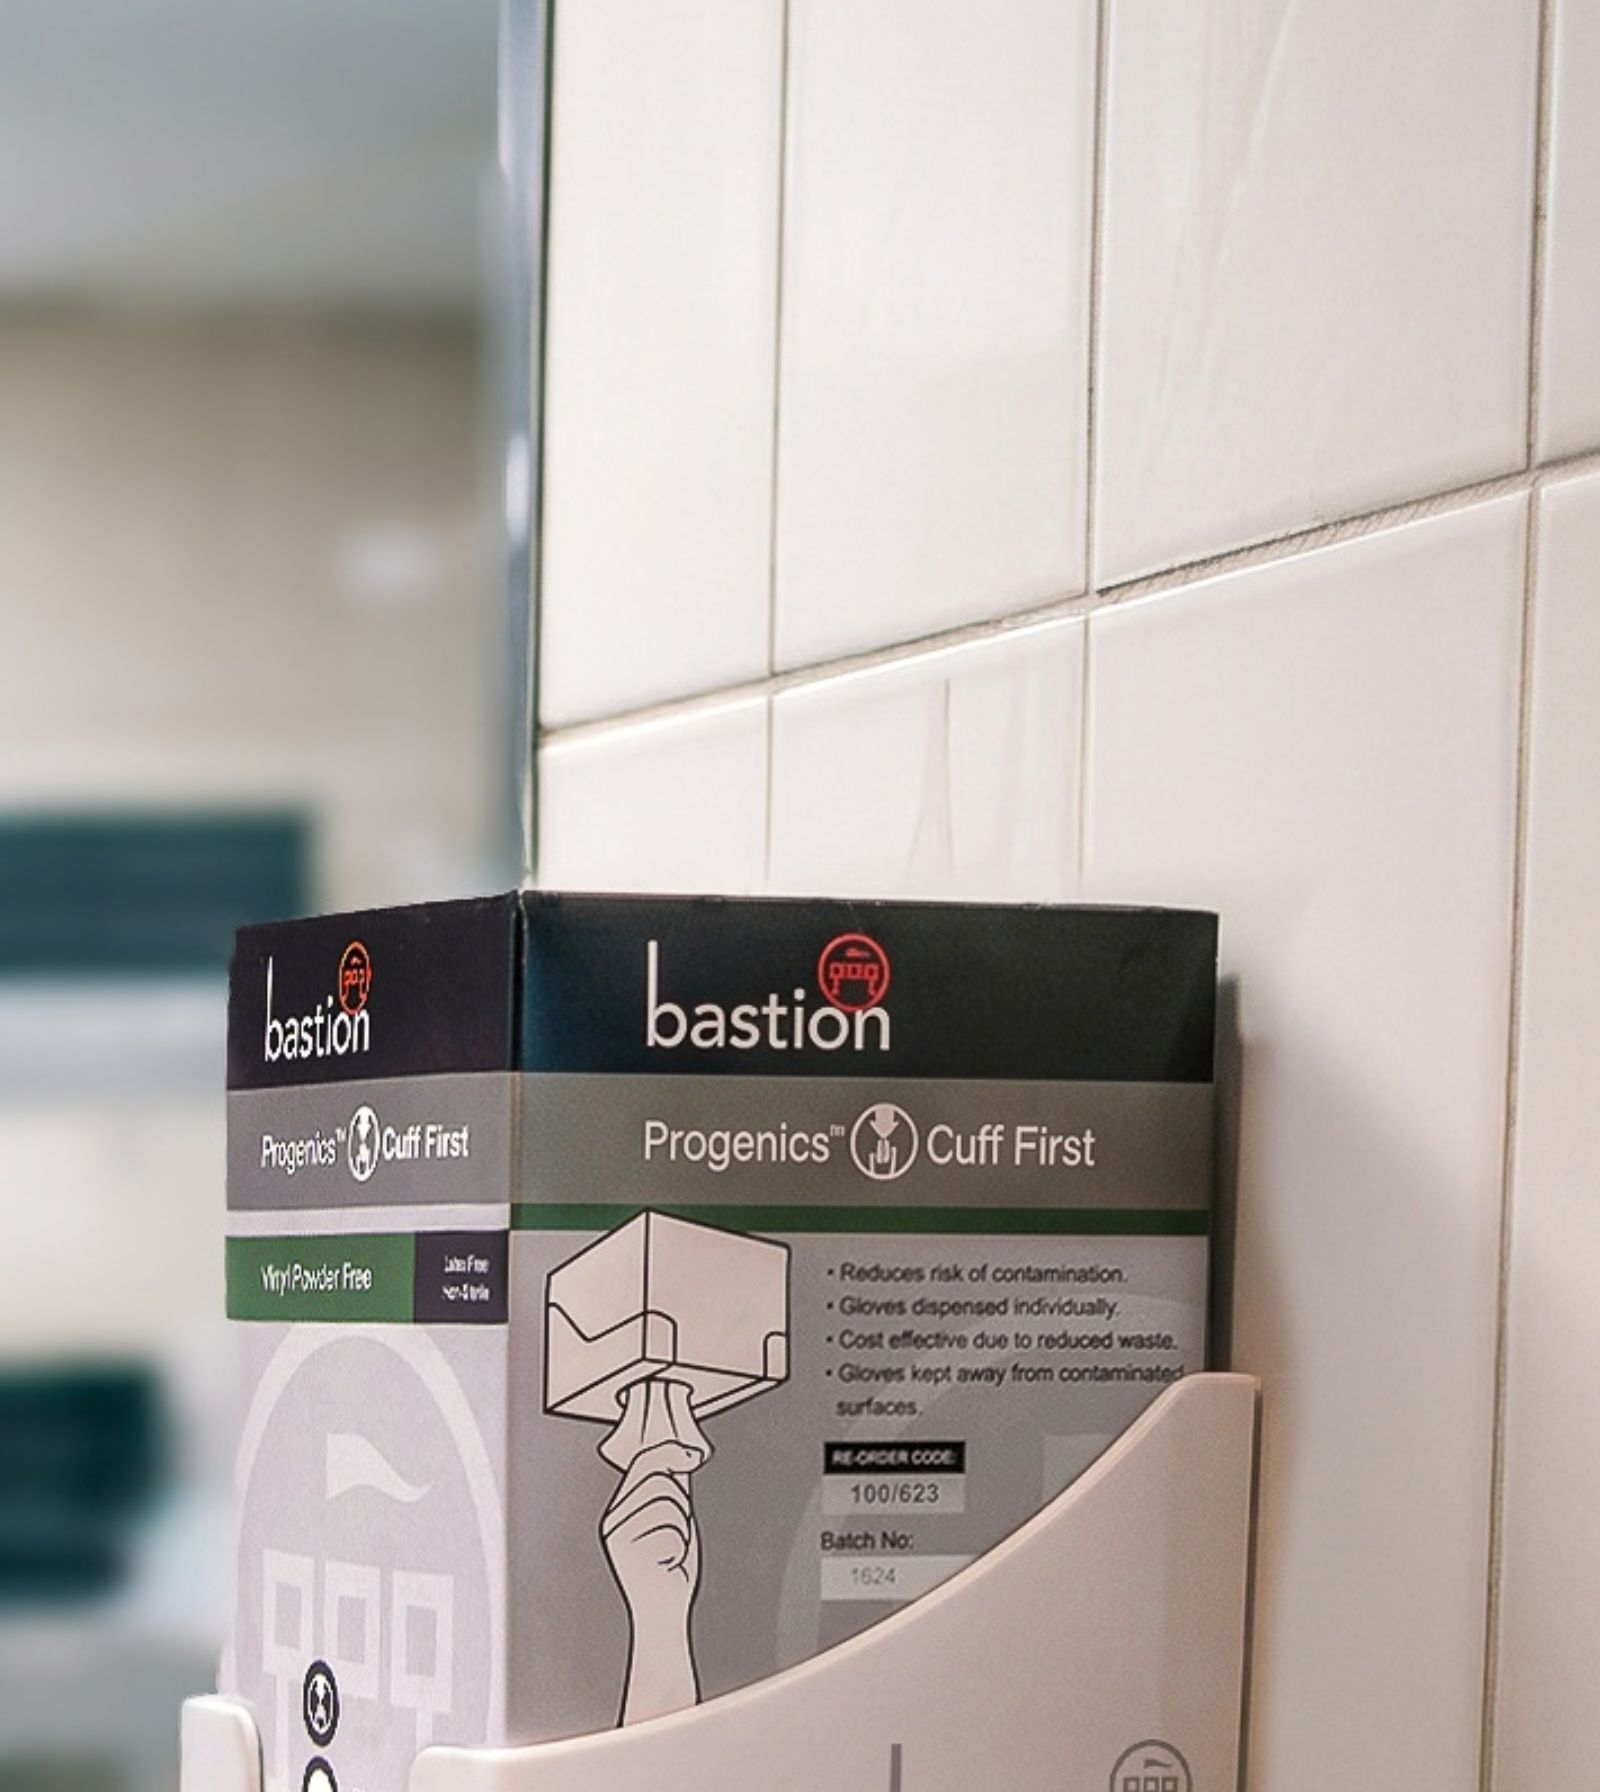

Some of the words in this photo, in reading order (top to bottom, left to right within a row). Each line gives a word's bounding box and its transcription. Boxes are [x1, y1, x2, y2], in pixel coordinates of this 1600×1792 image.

[646, 939, 890, 1051] bastion
[264, 956, 369, 1061] bastion
[382, 1128, 422, 1160] Cuff
[425, 1125, 469, 1159] First
[926, 1124, 1006, 1167] Cuff
[1014, 1125, 1095, 1168] First
[292, 1264, 340, 1292] Powder
[343, 1262, 372, 1291] Free
[839, 1263, 924, 1283] Reduces
[931, 1264, 962, 1283] risk
[969, 1265, 988, 1283] of
[994, 1265, 1128, 1283] contamination.
[839, 1296, 906, 1316] Gloves
[913, 1297, 1008, 1320] dispensed
[1014, 1298, 1120, 1320] individually.
[838, 1330, 884, 1350] Cost
[888, 1330, 968, 1350] effective
[973, 1331, 1008, 1350] due
[1014, 1333, 1032, 1350] to
[1038, 1332, 1113, 1351] reduced
[1118, 1334, 1178, 1351] waste.
[838, 1364, 905, 1383] Gloves
[912, 1364, 952, 1388] kept
[956, 1370, 1005, 1388] away
[1011, 1364, 1054, 1383] from
[1058, 1364, 1184, 1383] contaminated
[836, 1398, 923, 1417] surfaces.
[851, 1484, 940, 1504] 100/623
[821, 1532, 876, 1550] Batch
[881, 1532, 913, 1550] No:
[851, 1567, 896, 1585] 1624
